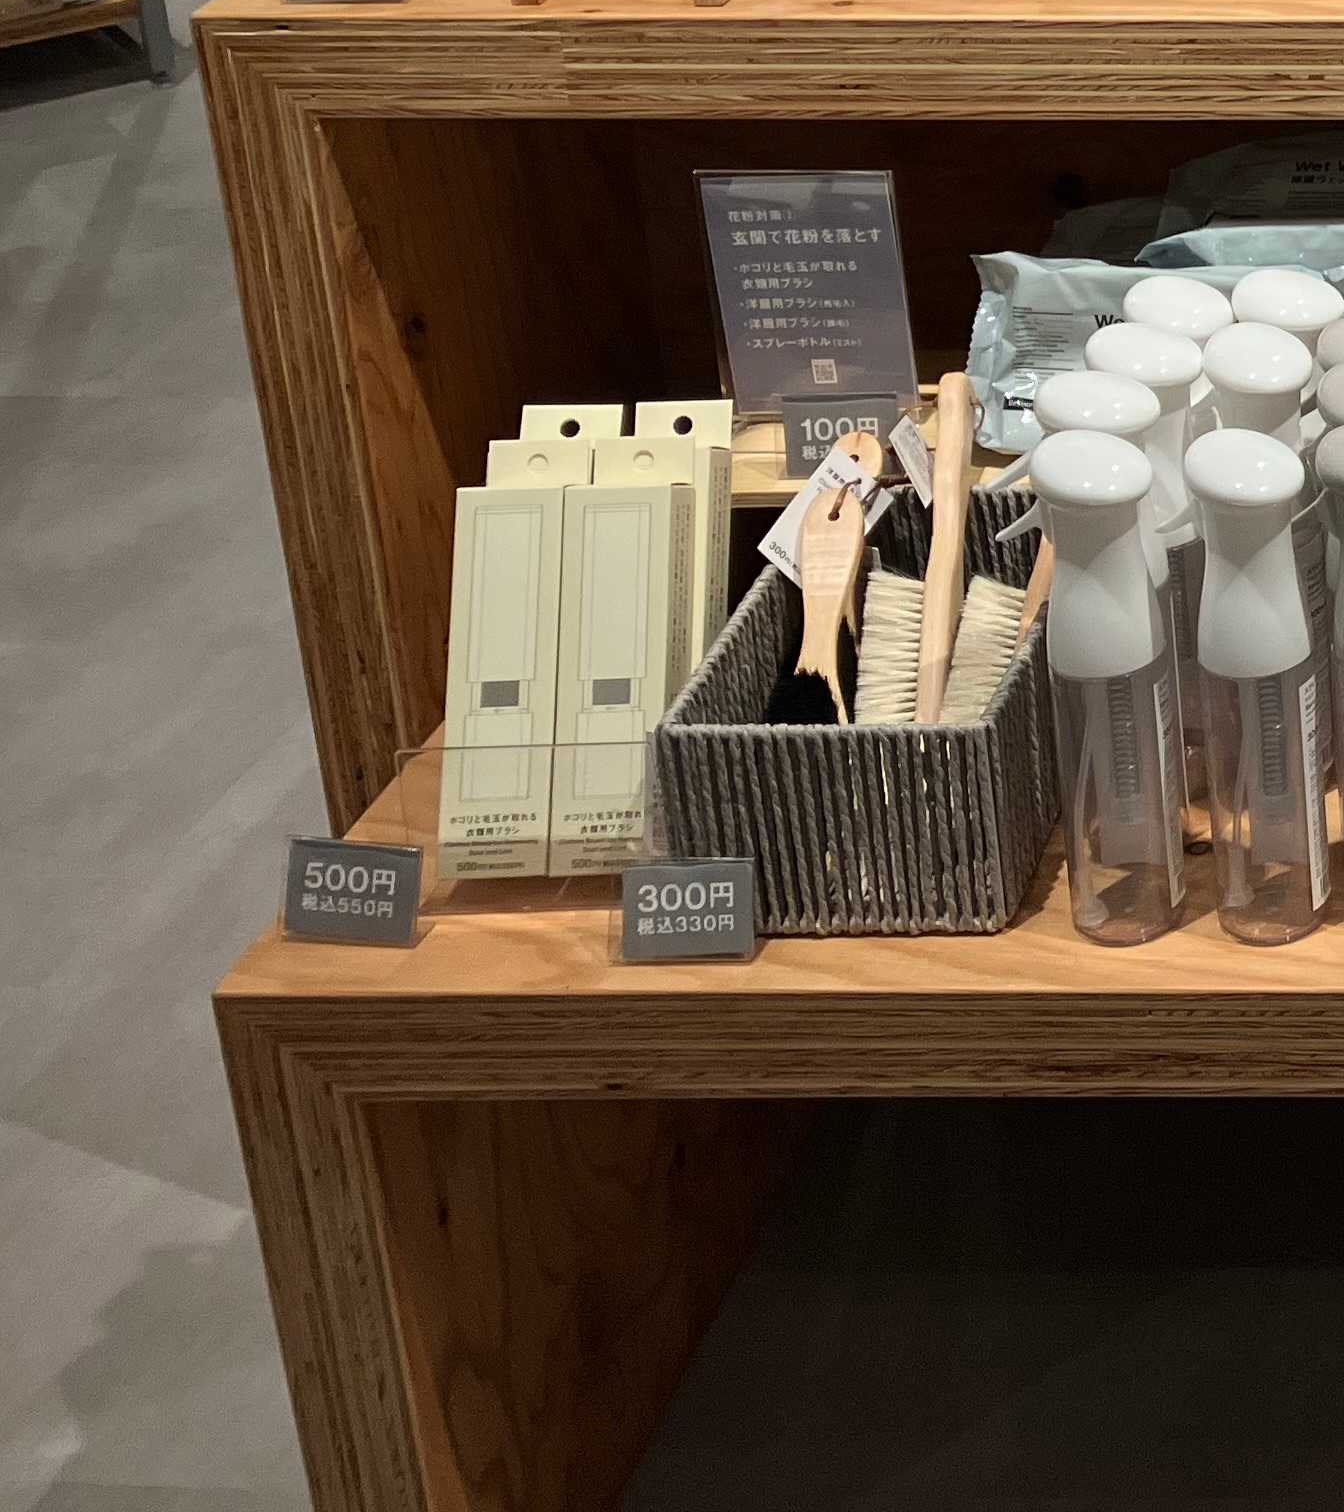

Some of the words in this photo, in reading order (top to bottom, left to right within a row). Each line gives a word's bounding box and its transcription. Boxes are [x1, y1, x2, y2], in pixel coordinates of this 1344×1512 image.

[1295, 160, 1335, 173] Wet
[731, 228, 882, 246] 玄関で花粉を落とす
[800, 417, 879, 442] 100円
[303, 861, 397, 897] 500円
[302, 893, 394, 920] 税込550円
[637, 881, 734, 913] 300円
[636, 913, 735, 936] 税込330円
